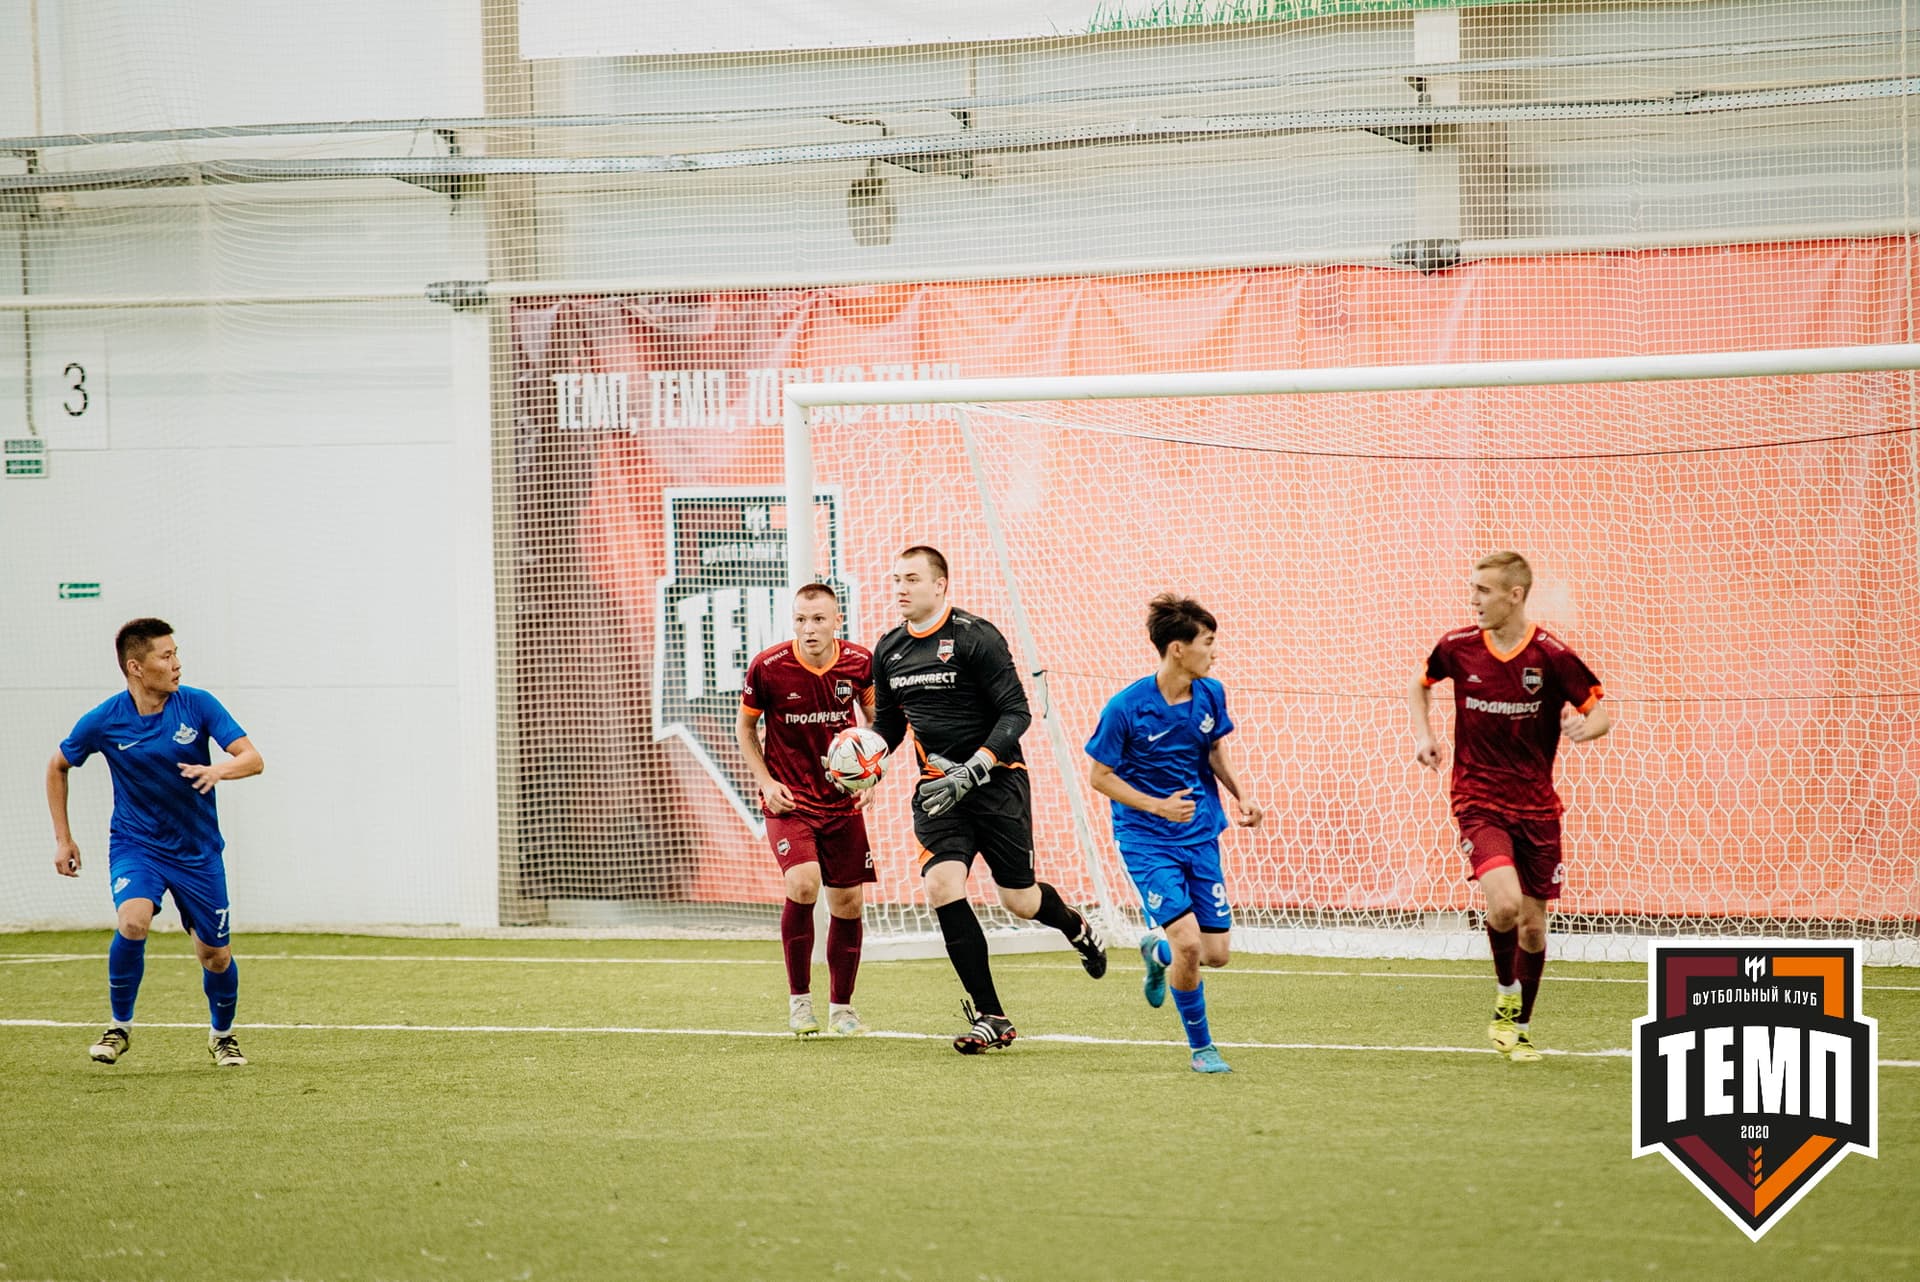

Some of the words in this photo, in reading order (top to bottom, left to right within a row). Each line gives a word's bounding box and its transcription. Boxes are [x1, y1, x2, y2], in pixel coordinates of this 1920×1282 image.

[63, 362, 87, 416] 3
[552, 373, 638, 435] ТЕМП,
[650, 370, 735, 433] ТЕМП,
[743, 364, 863, 426] ТОКО
[678, 584, 796, 702] ТЕМ
[1211, 882, 1226, 908] 9
